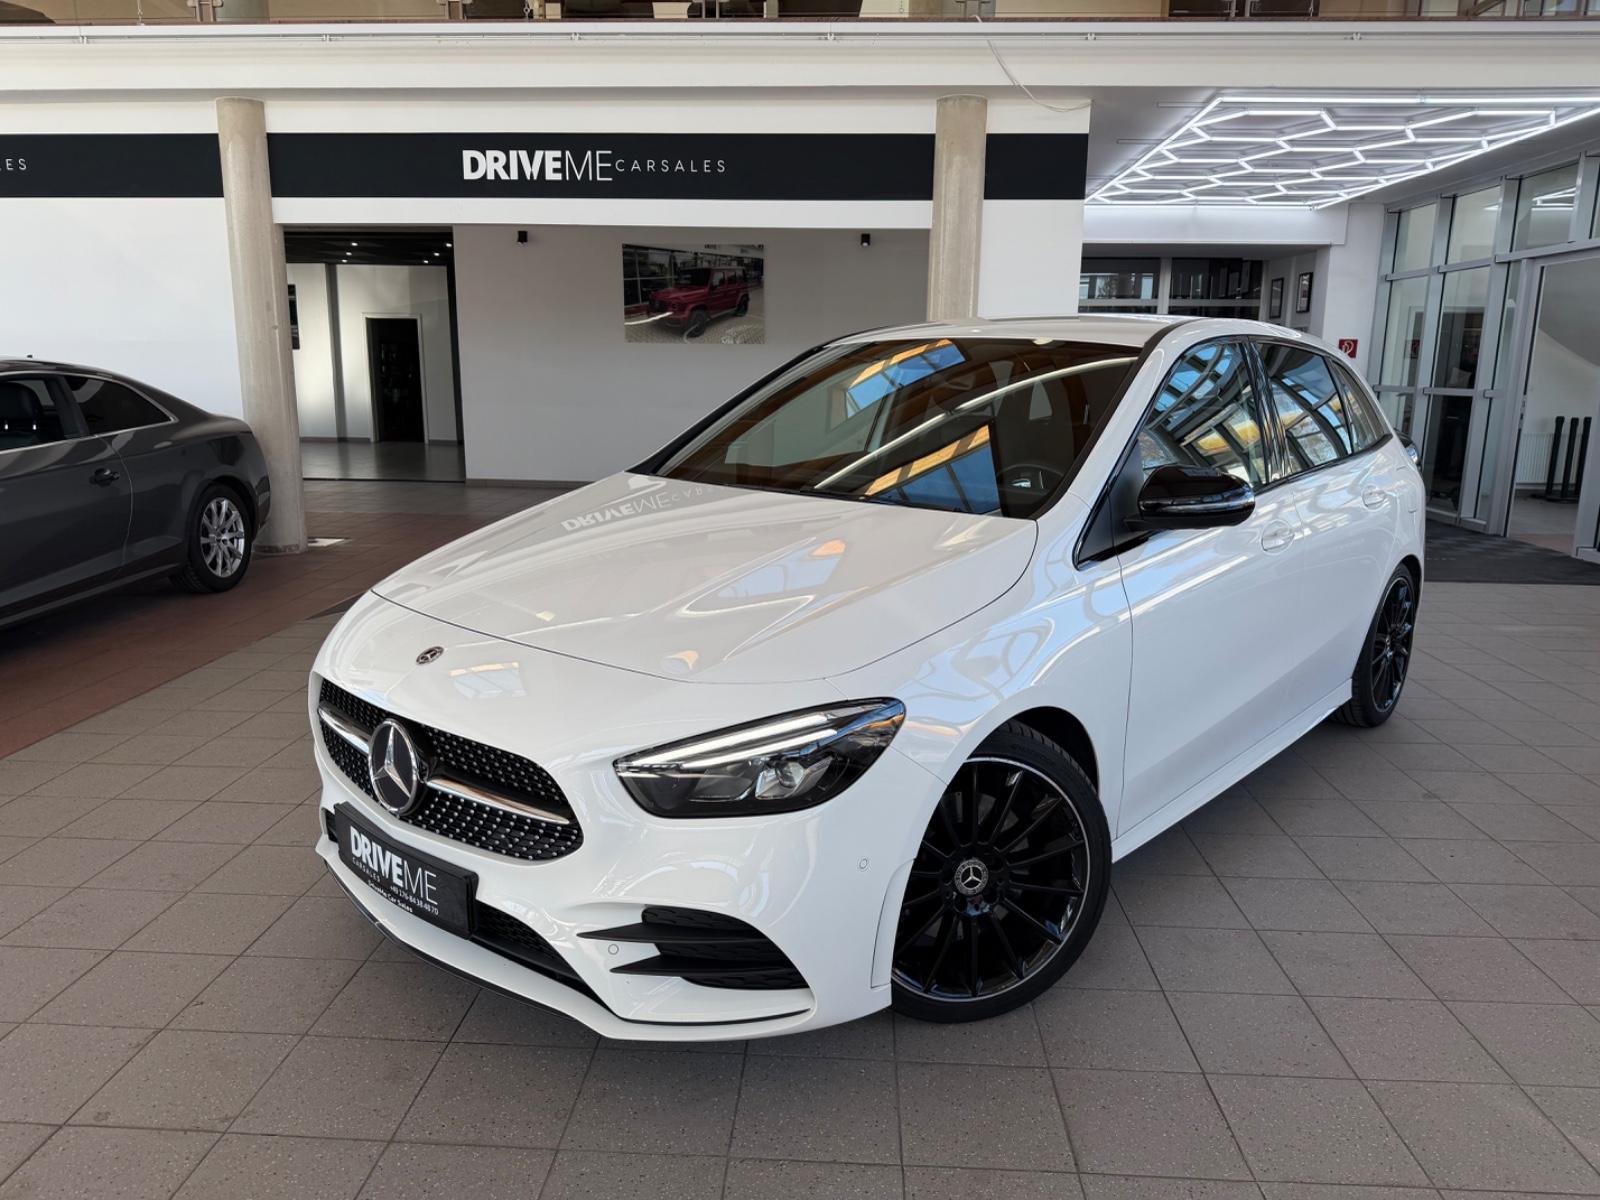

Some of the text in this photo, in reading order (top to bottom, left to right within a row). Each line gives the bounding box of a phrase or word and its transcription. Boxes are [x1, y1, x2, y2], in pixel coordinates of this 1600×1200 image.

[0, 158, 27, 171] ES
[462, 150, 726, 181] DRIVEME CARSALES
[350, 826, 438, 905] DRIVEME
